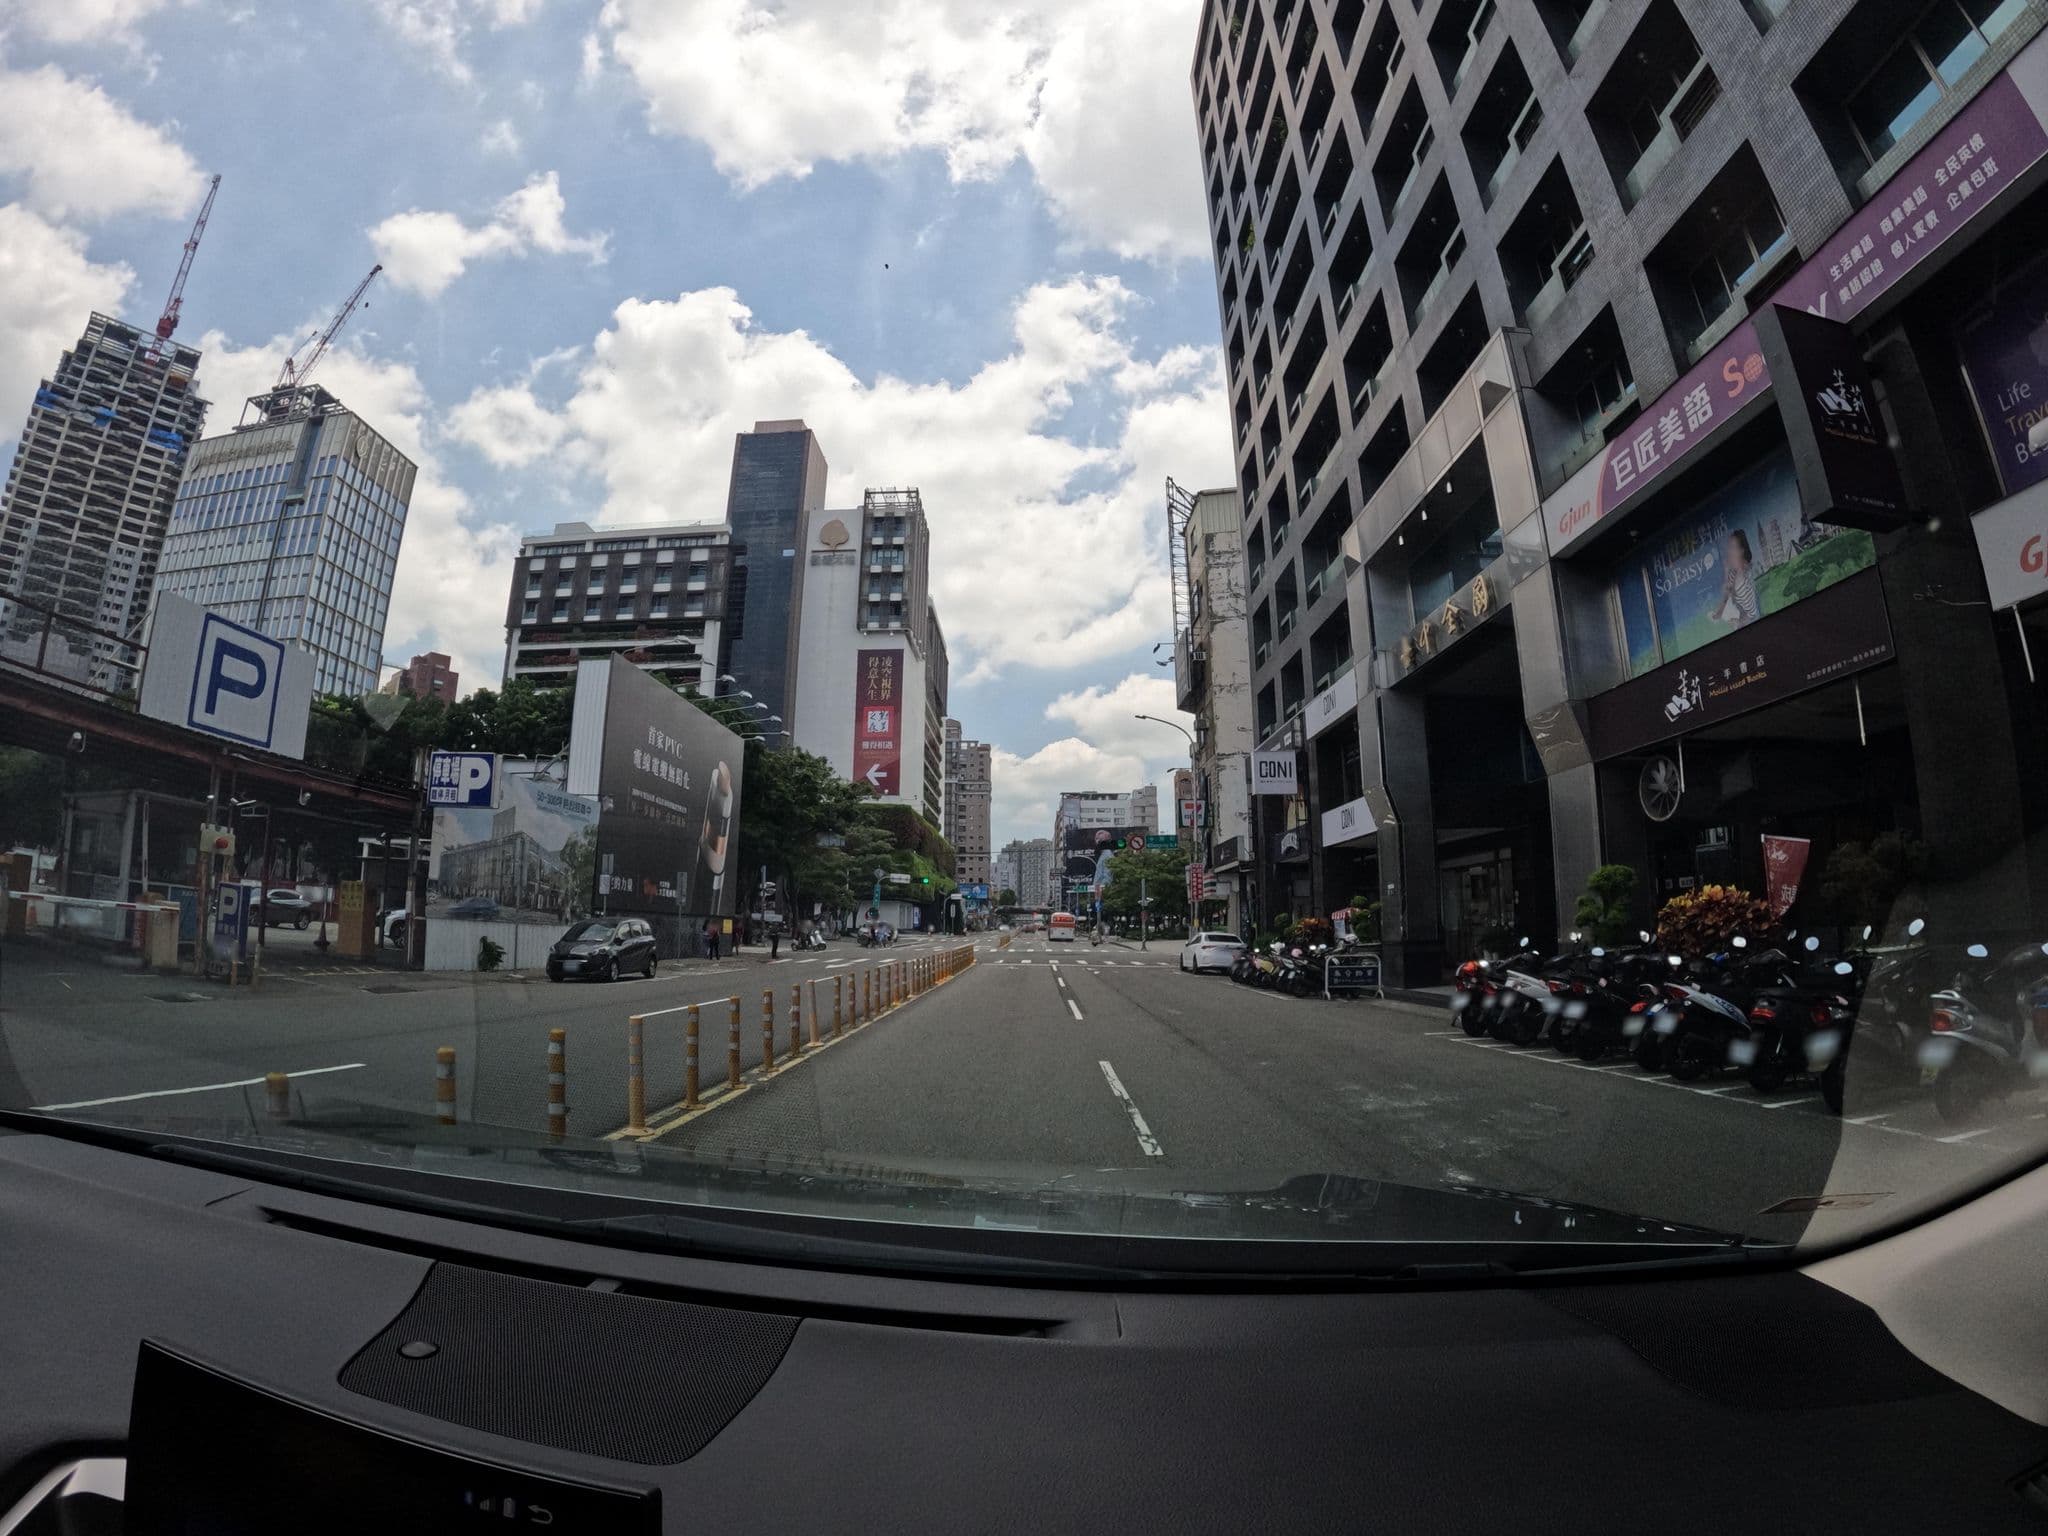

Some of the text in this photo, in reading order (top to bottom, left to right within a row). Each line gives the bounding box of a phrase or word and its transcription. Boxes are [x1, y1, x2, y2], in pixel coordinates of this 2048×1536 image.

[1830, 132, 1986, 281] 生活美語 商業美語 全民英檢
[1890, 209, 1940, 259] 個人家教
[1946, 156, 1999, 210] 企業包班
[1998, 382, 2031, 412] Life
[1610, 382, 1713, 491] 巨匠美語
[1559, 501, 1591, 535] Gjun
[1654, 558, 1704, 598] So Easy
[205, 638, 267, 715] P
[1708, 654, 1765, 687] 二手書店
[1323, 690, 1337, 716] CONI
[432, 756, 460, 786] 停車場
[458, 757, 491, 803] P
[1259, 761, 1292, 779] CONI
[1341, 806, 1356, 830] CONI
[218, 886, 239, 921] P
